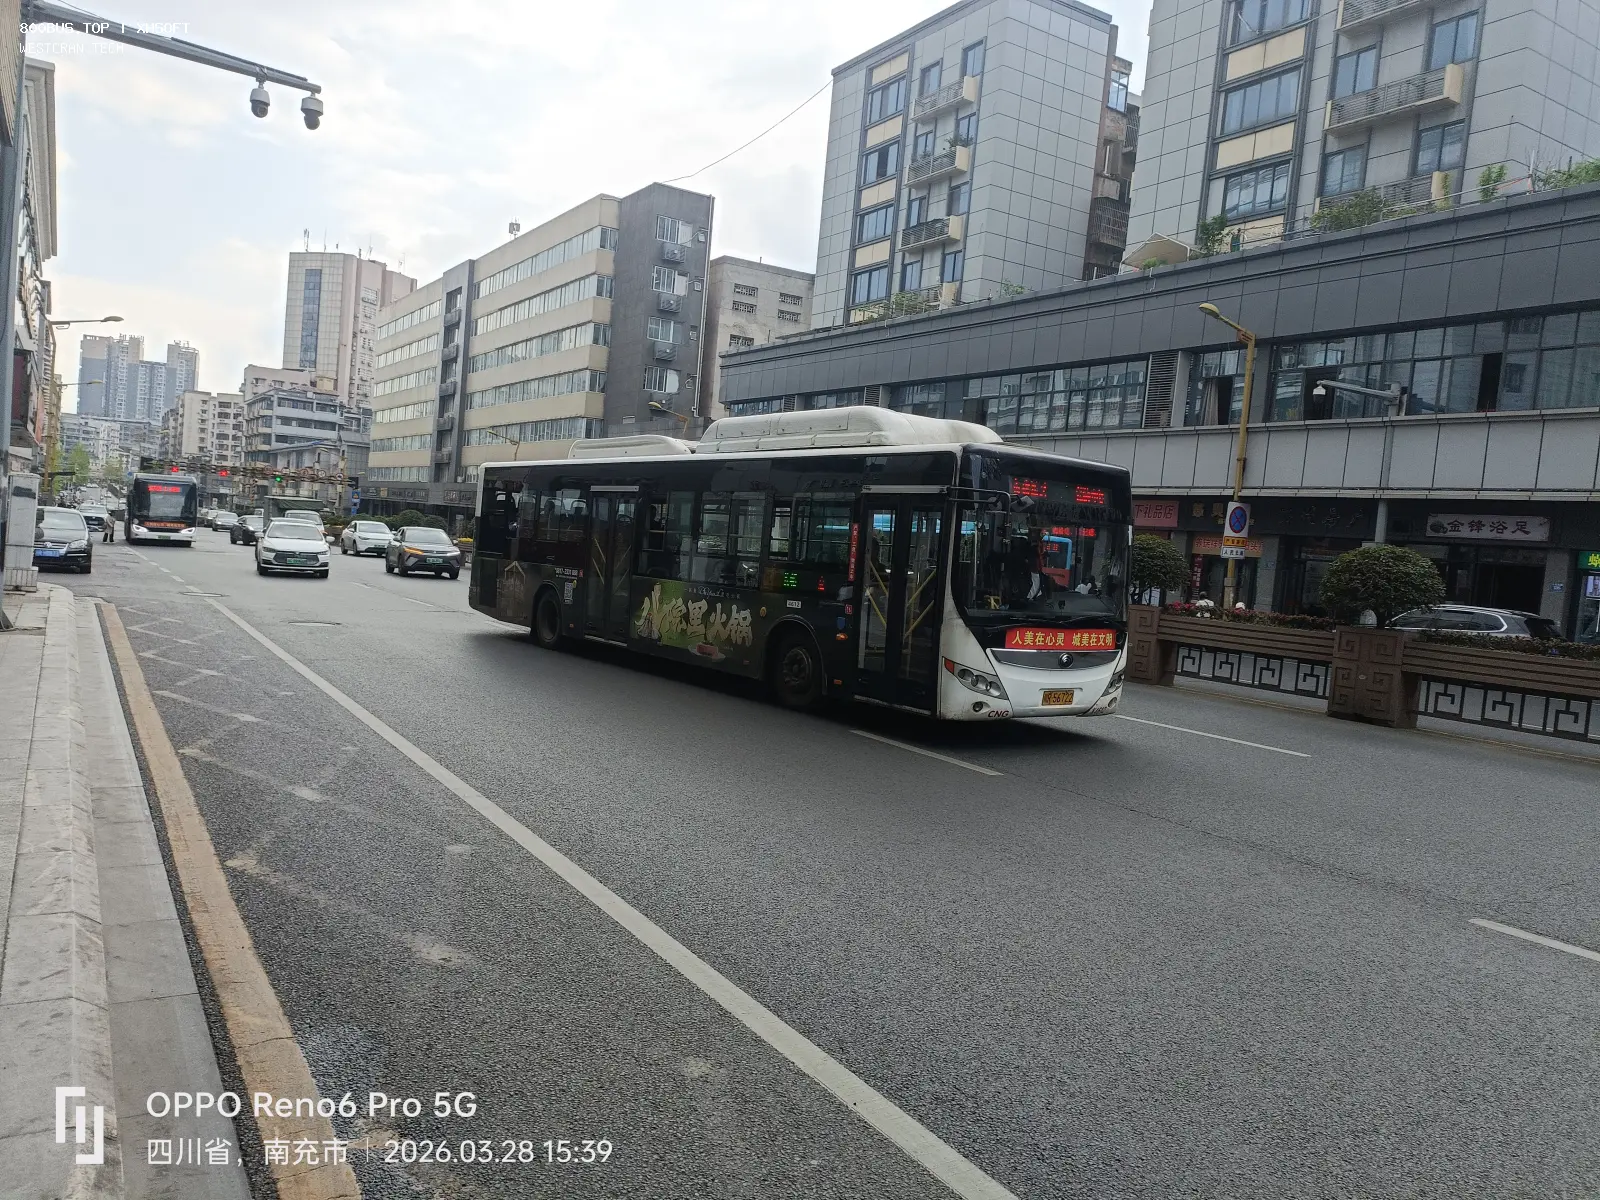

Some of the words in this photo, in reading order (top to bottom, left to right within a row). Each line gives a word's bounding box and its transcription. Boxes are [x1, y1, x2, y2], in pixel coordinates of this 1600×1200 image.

[1011, 630, 1065, 646] 人美在心灵
[1071, 632, 1113, 646] 城美在文明
[988, 710, 1009, 718] CNG
